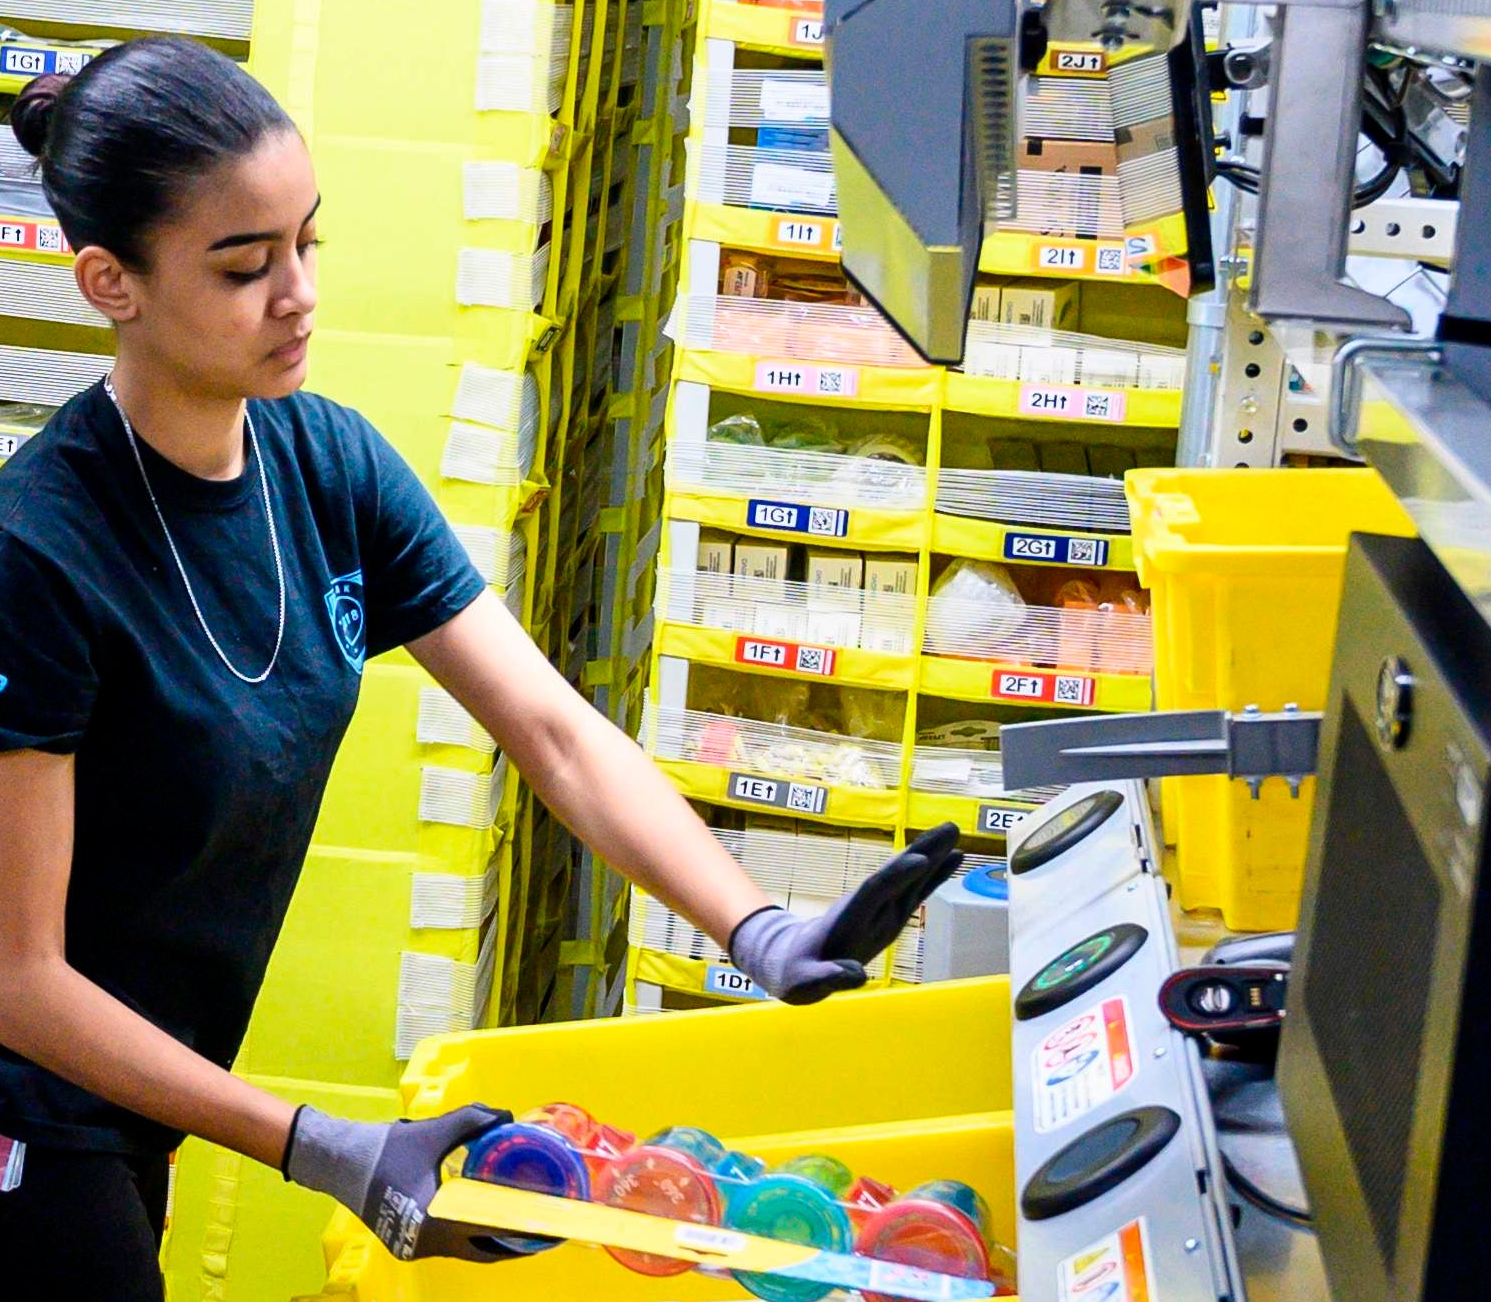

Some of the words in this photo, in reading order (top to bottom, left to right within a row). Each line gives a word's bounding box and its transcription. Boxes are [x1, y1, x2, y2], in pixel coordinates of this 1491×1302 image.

[1061, 54, 1087, 70] 2J
[767, 370, 792, 386] 1H
[1031, 392, 1057, 409] 2H
[760, 507, 786, 524] 1G
[1017, 539, 1043, 556] 2G
[750, 643, 772, 660] 1F
[1006, 675, 1029, 693] 2F
[739, 778, 764, 797] 1E
[718, 973, 744, 990] 1D
